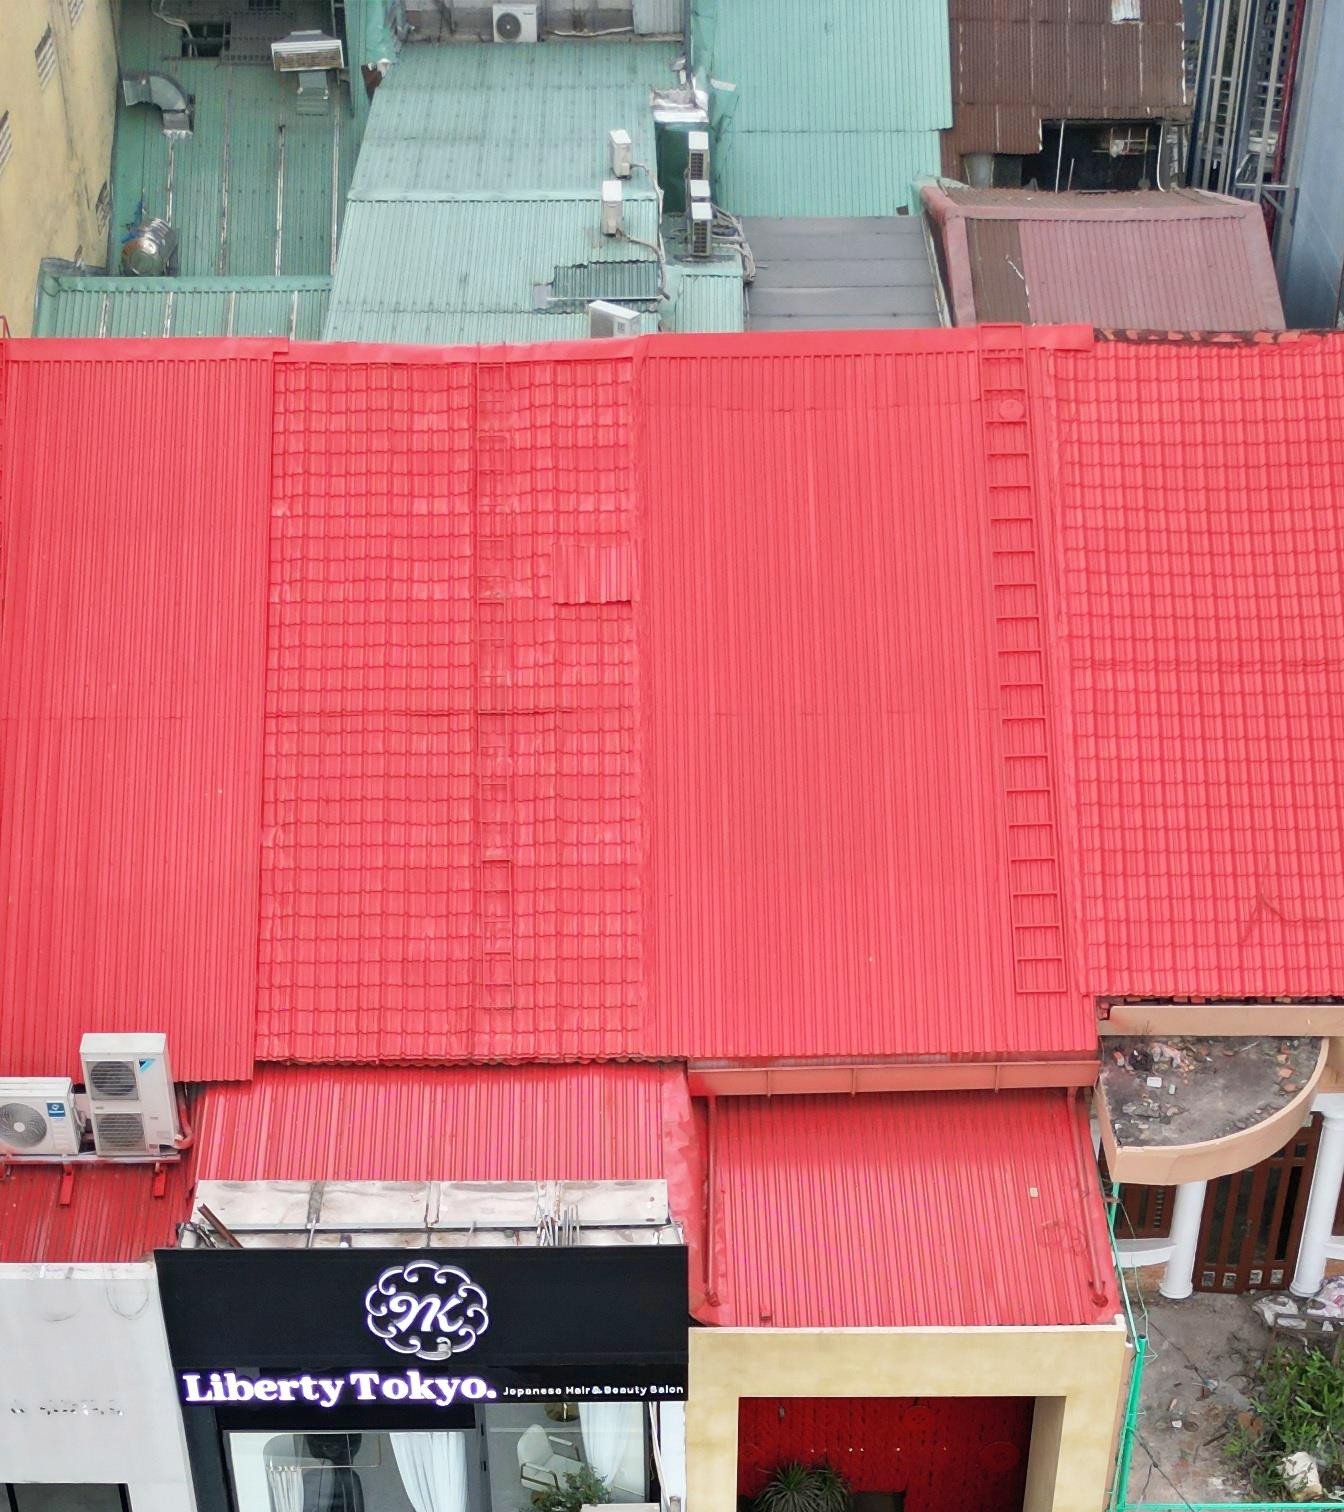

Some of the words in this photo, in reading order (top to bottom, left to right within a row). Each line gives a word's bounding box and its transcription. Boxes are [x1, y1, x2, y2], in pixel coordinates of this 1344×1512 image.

[183, 1371, 345, 1409] Liberty
[503, 1386, 562, 1397] Japanese
[565, 1386, 590, 1395] Hair
[604, 1386, 647, 1396] Beauty
[649, 1385, 684, 1394] Salon
